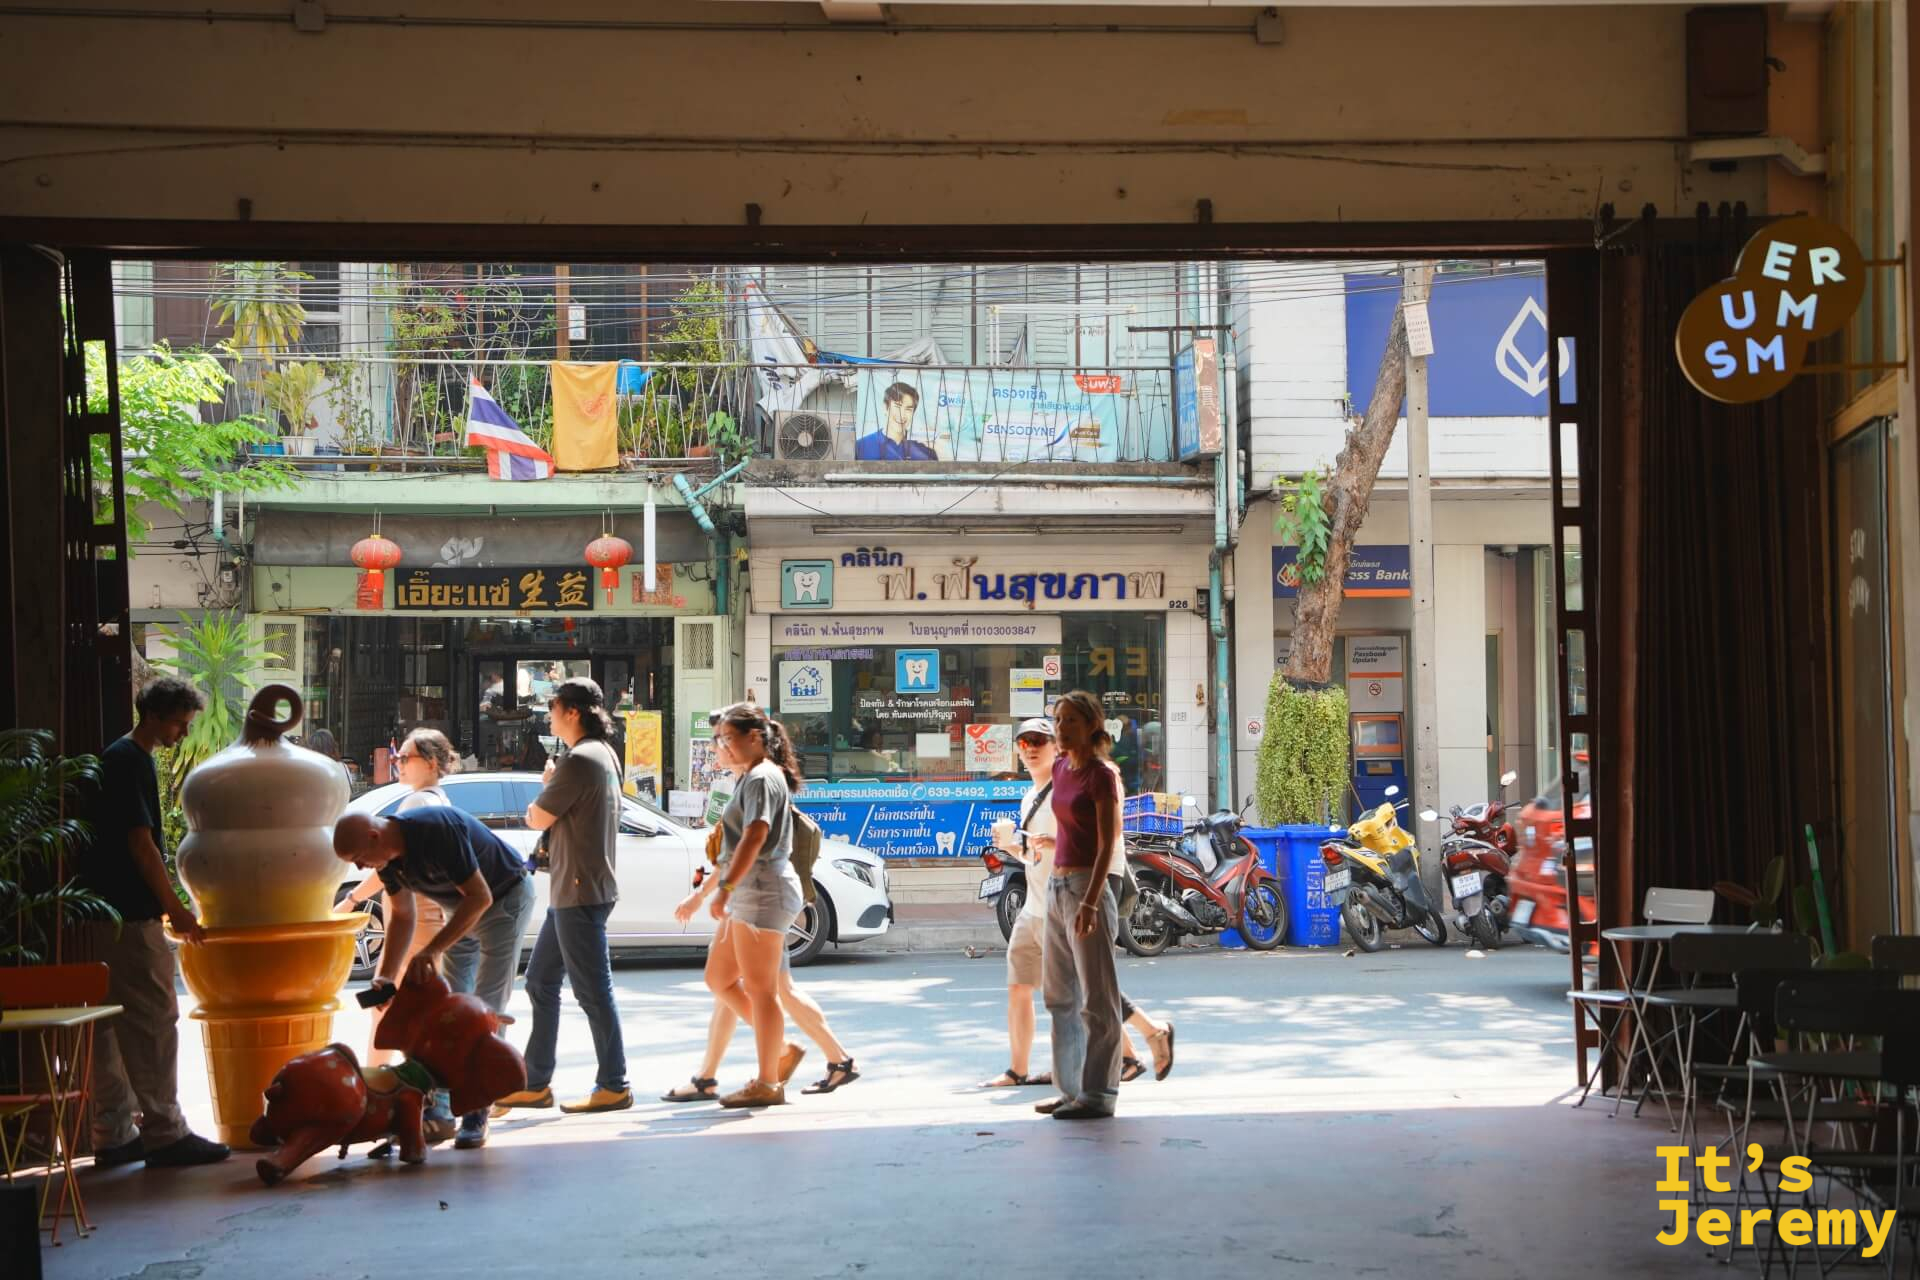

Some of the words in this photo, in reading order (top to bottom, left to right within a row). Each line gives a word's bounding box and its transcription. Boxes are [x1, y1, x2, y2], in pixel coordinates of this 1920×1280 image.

[986, 424, 1056, 437] SENSODYNE
[841, 546, 903, 568] คลินิก
[785, 623, 816, 637] คลินิก
[909, 619, 969, 640] ใบอนุญาตที่
[971, 625, 1036, 636] 10103003847
[928, 786, 988, 799] 639-5492,
